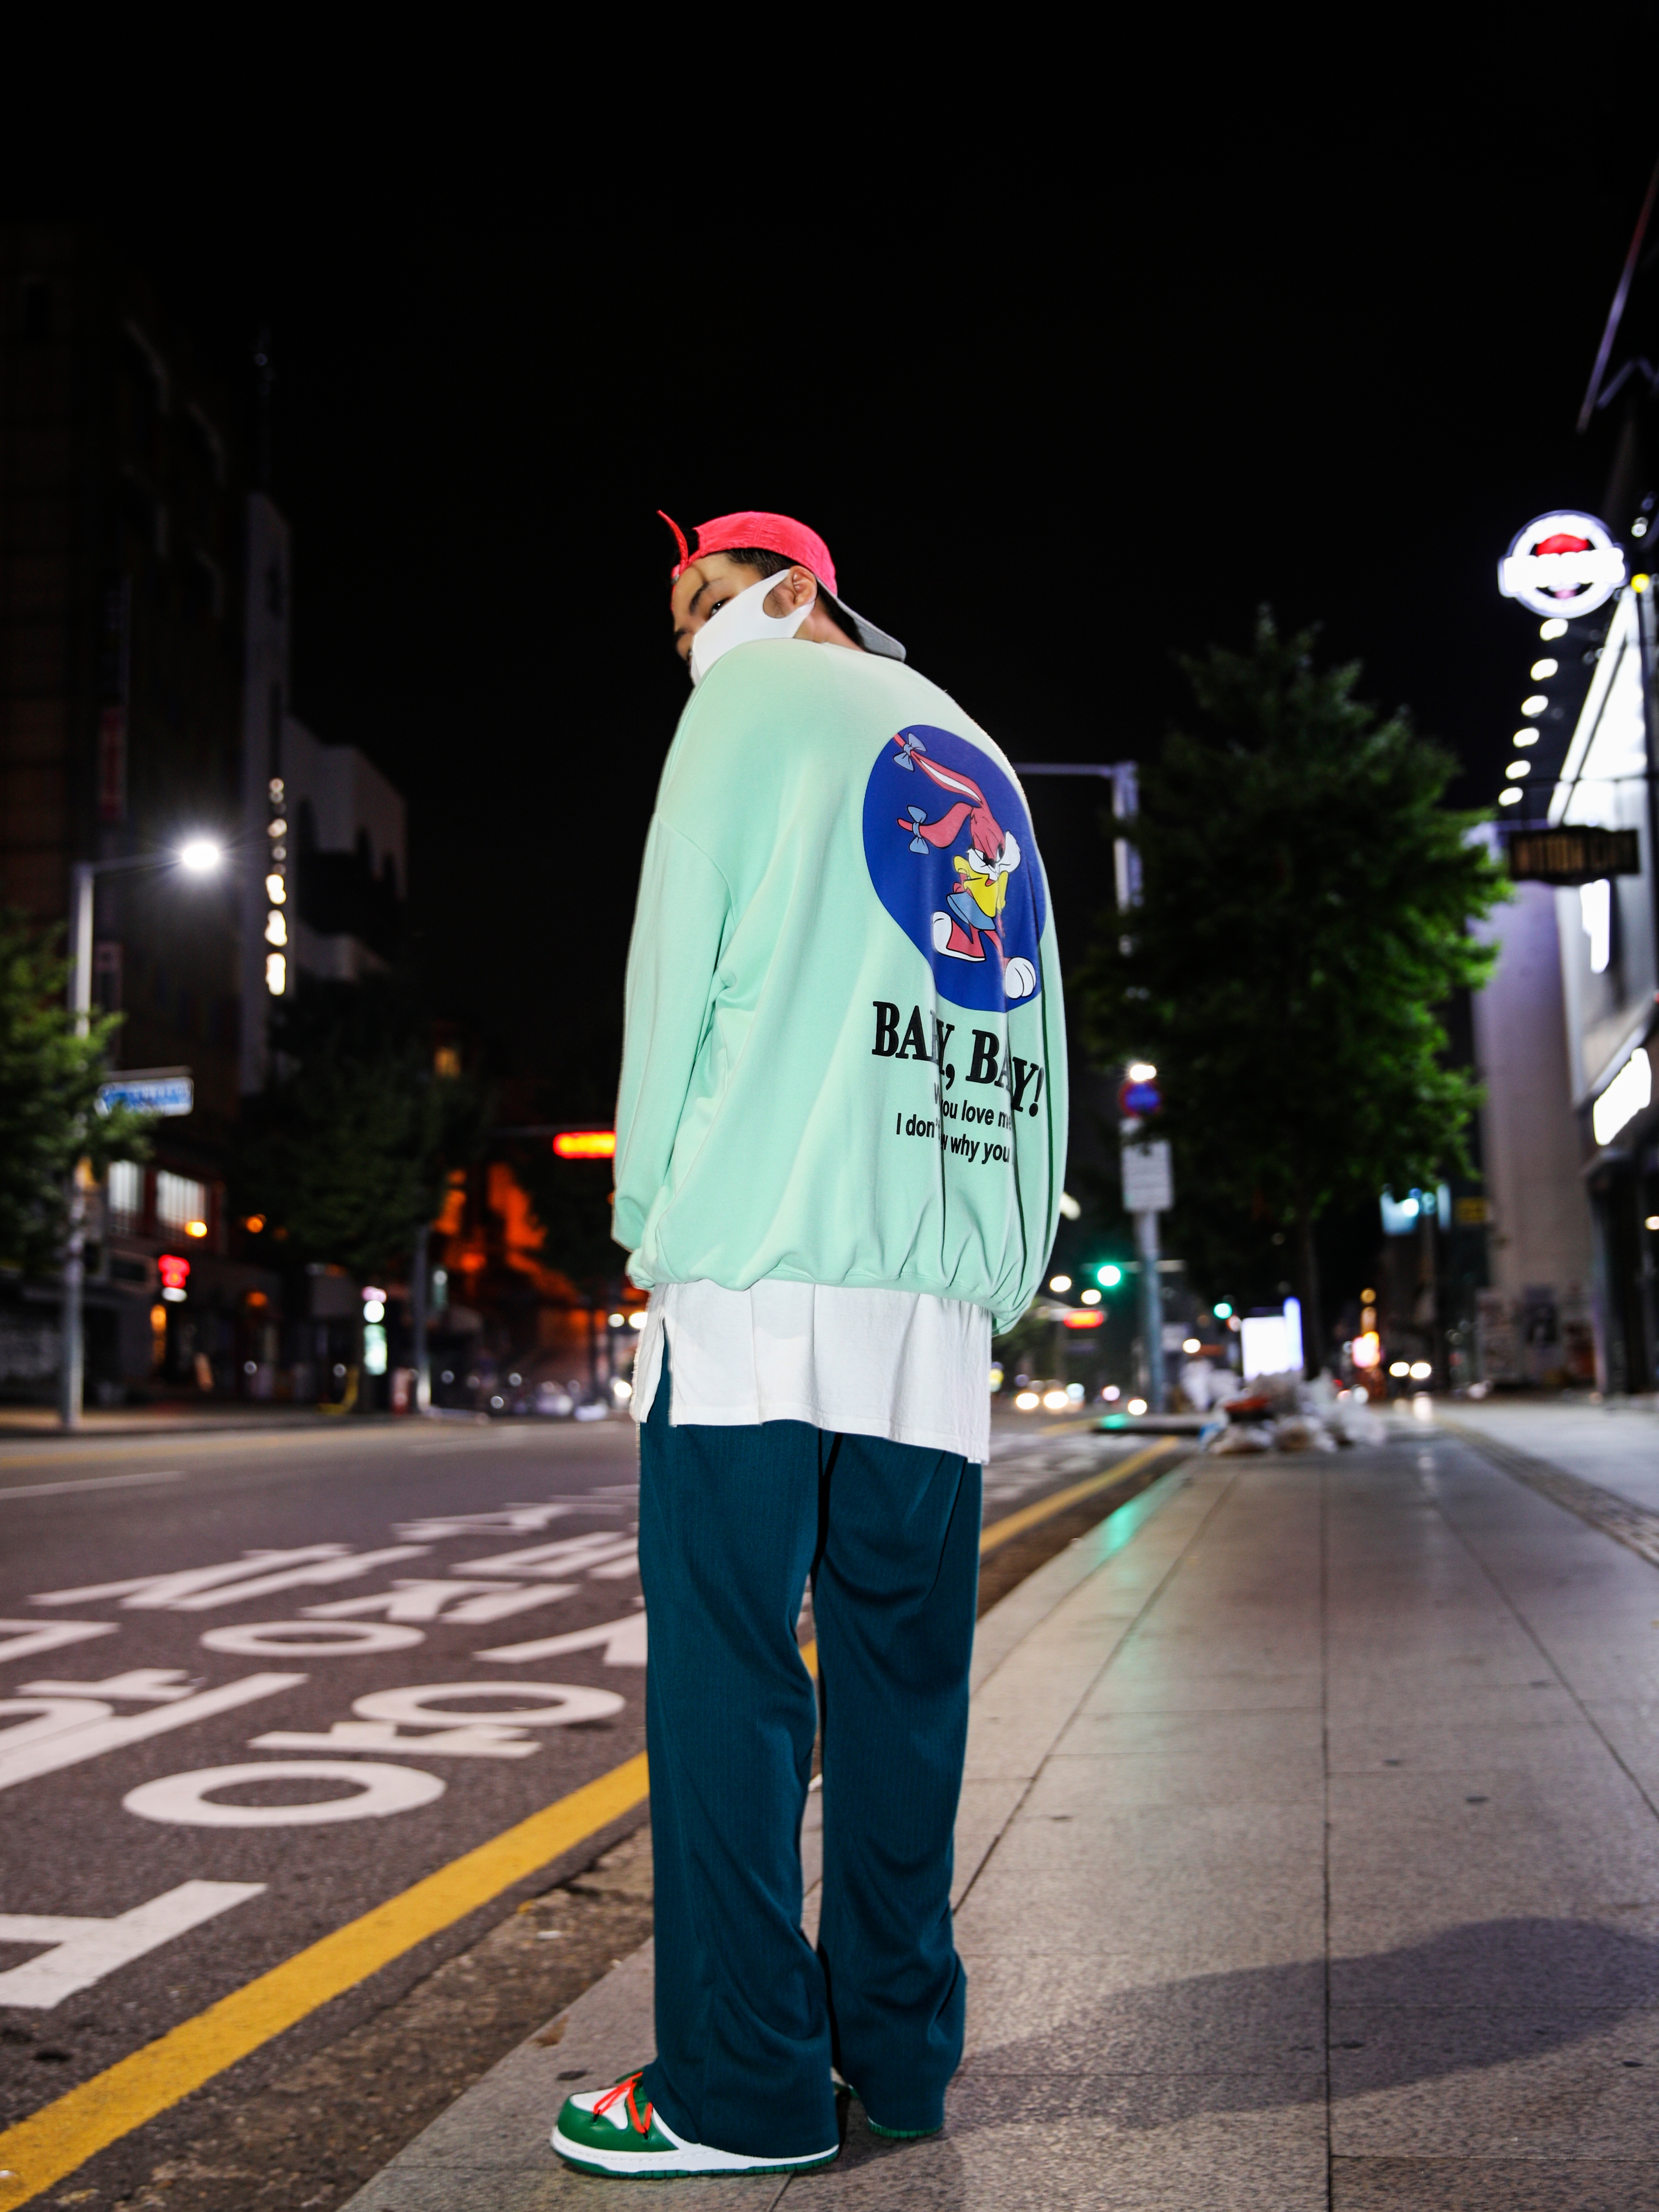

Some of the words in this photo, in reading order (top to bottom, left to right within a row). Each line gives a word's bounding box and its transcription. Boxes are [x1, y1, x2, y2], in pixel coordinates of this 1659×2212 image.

[941, 1100, 958, 1120] ou
[961, 1100, 994, 1125] love
[896, 1112, 902, 1135] I
[951, 1134, 980, 1162] why
[981, 1142, 1010, 1164] you
